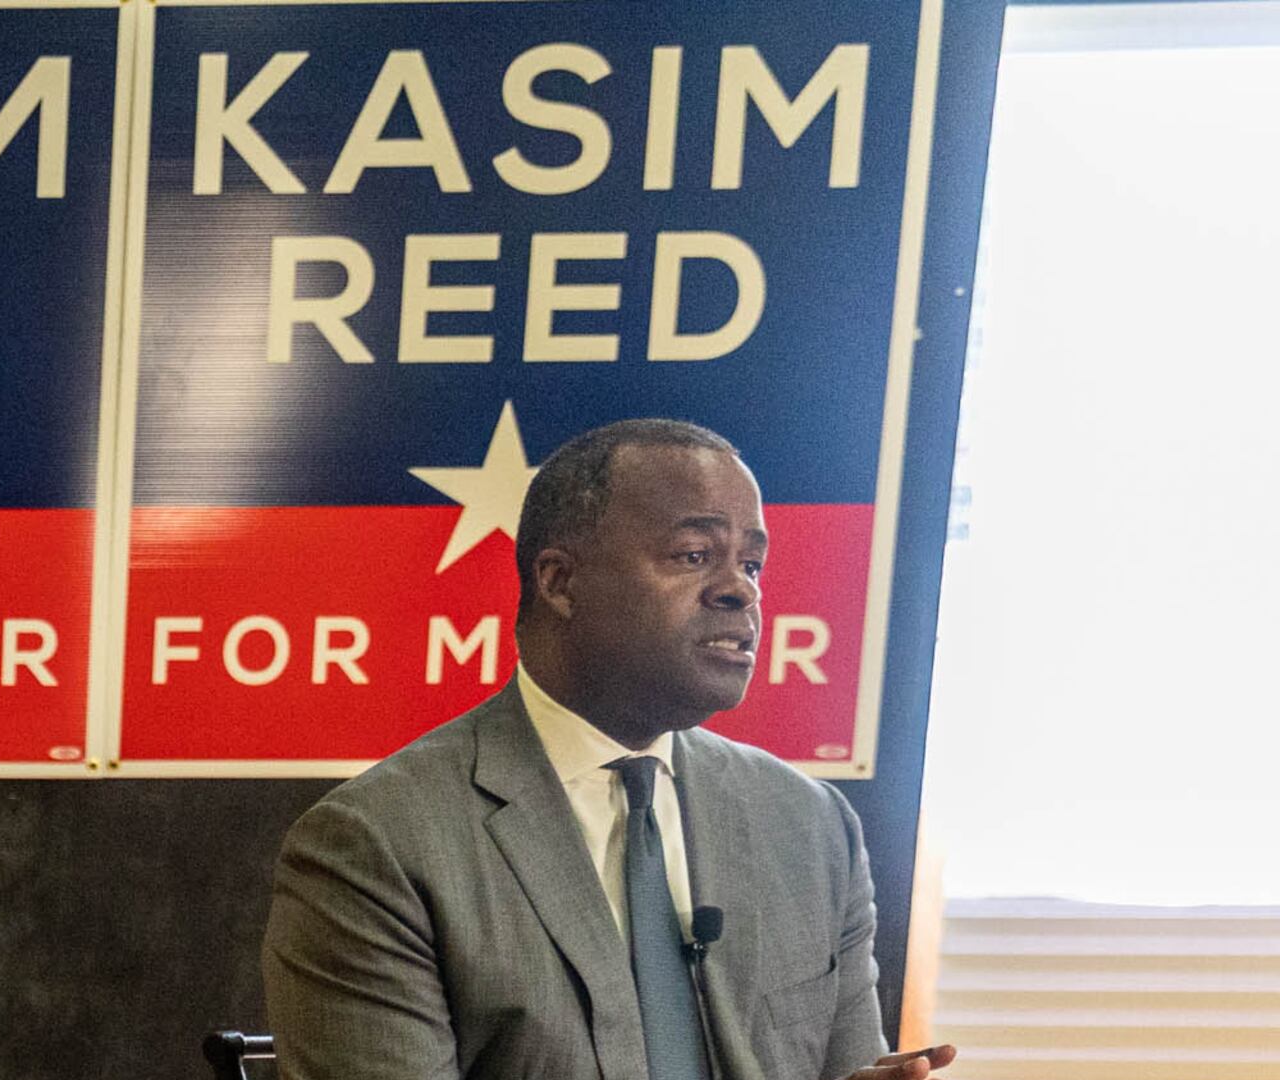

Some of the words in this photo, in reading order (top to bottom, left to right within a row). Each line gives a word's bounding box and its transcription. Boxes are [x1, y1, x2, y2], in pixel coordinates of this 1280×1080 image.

[192, 43, 870, 195] KASIM
[266, 231, 766, 363] REED
[151, 615, 371, 686] FOR
